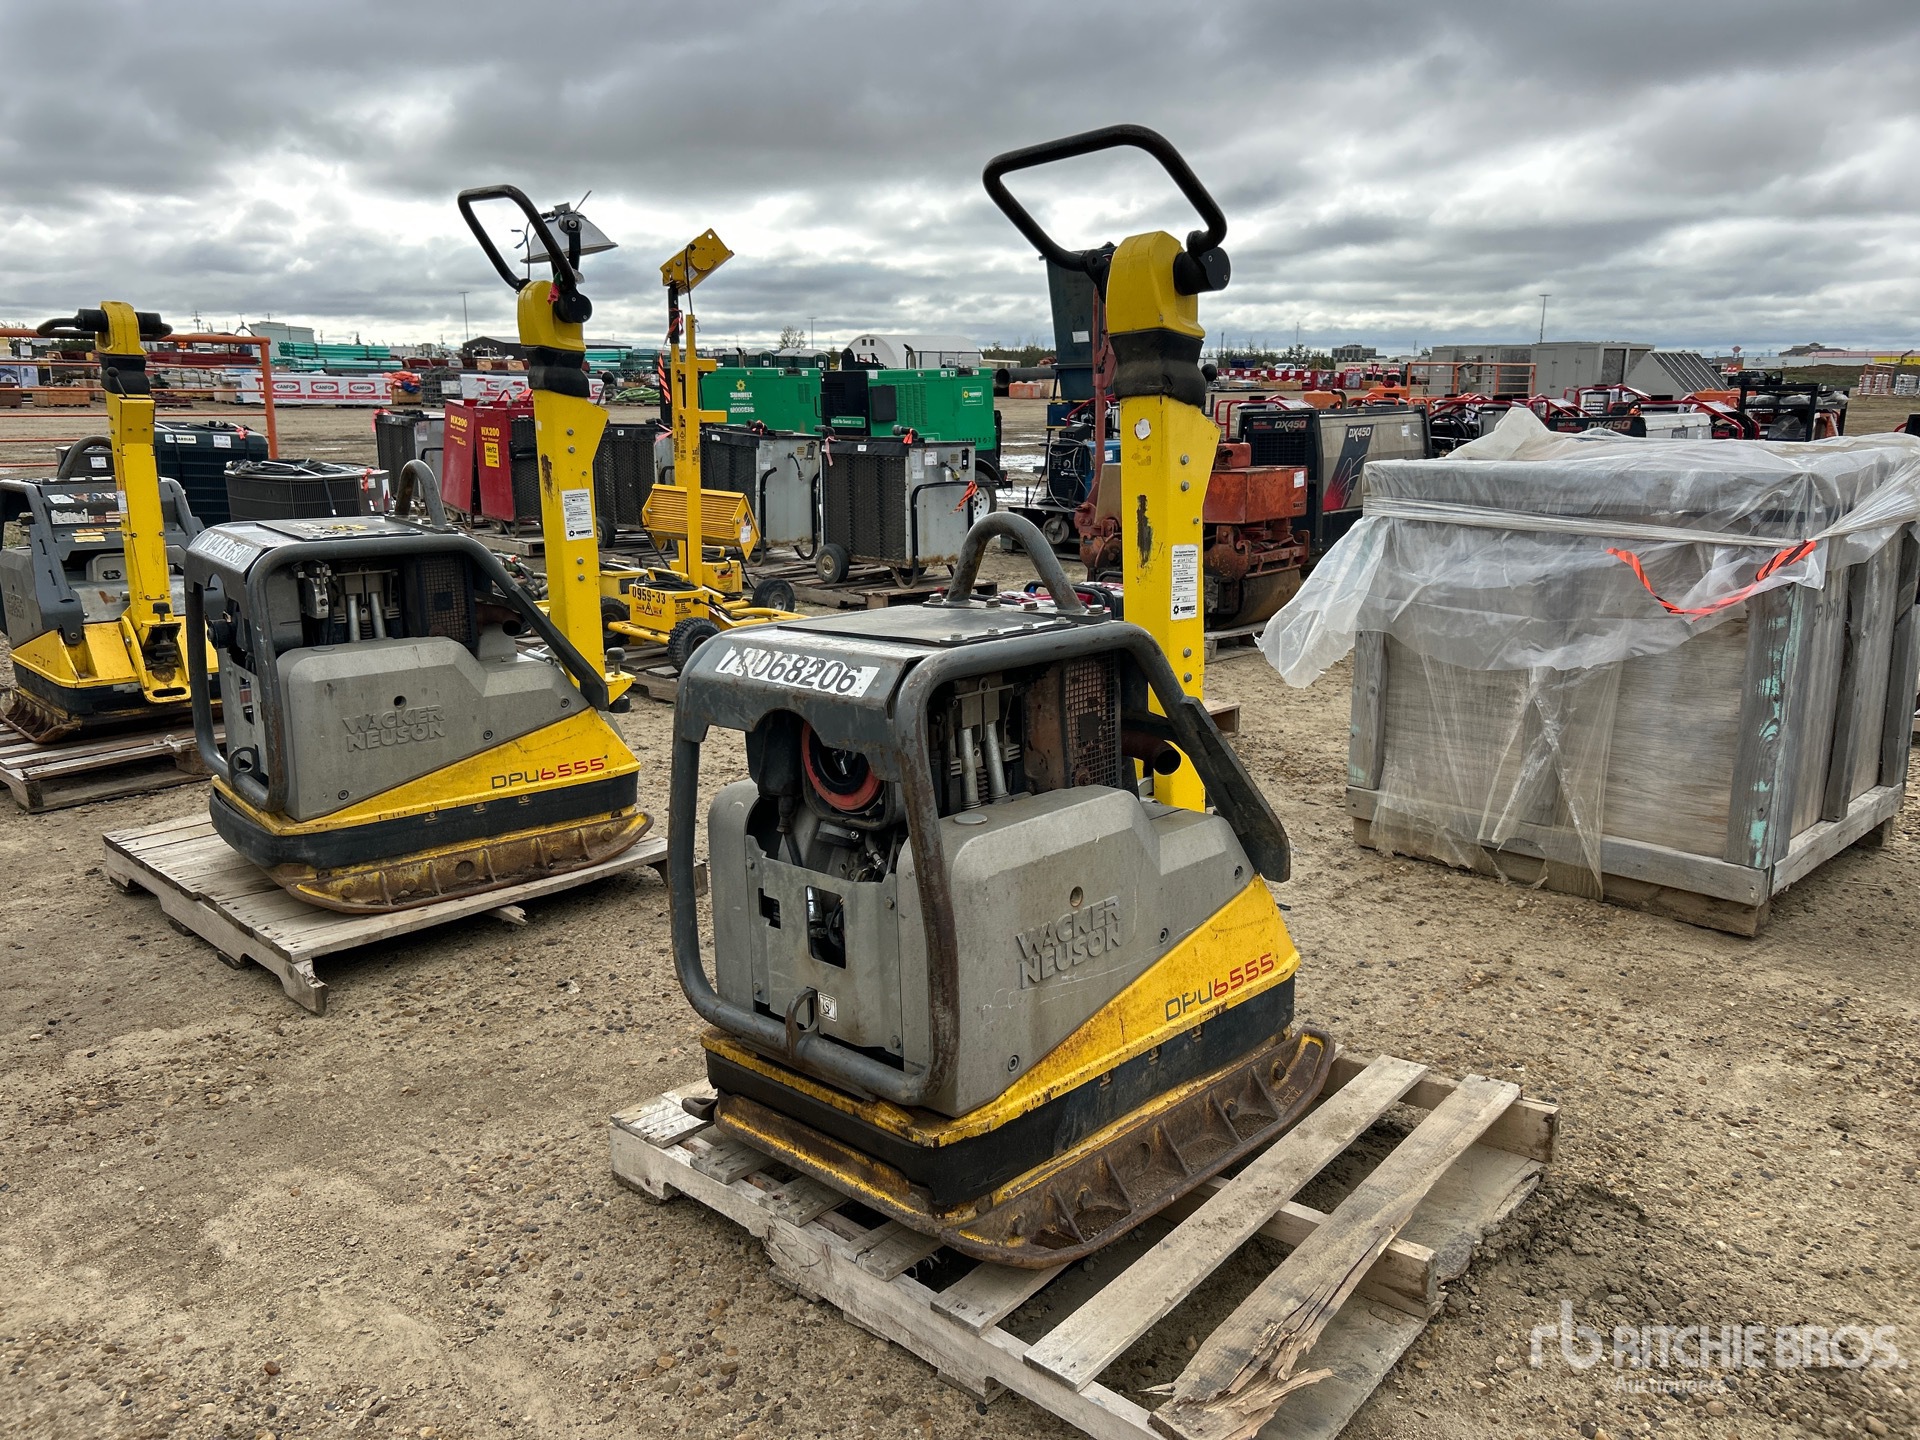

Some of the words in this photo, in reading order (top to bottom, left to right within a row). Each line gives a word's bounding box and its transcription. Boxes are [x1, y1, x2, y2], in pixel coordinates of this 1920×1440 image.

[451, 414, 468, 428] HX200
[481, 426, 500, 437] HX200
[1274, 420, 1307, 432] DX450
[1348, 427, 1371, 442] DX450
[342, 704, 446, 735] WACKER
[346, 723, 446, 752] NEUSON
[491, 756, 605, 790] DPU6555
[1015, 895, 1122, 960] WACKER
[1019, 922, 1123, 990] NEUSON
[1164, 952, 1275, 1022] DPU6555
